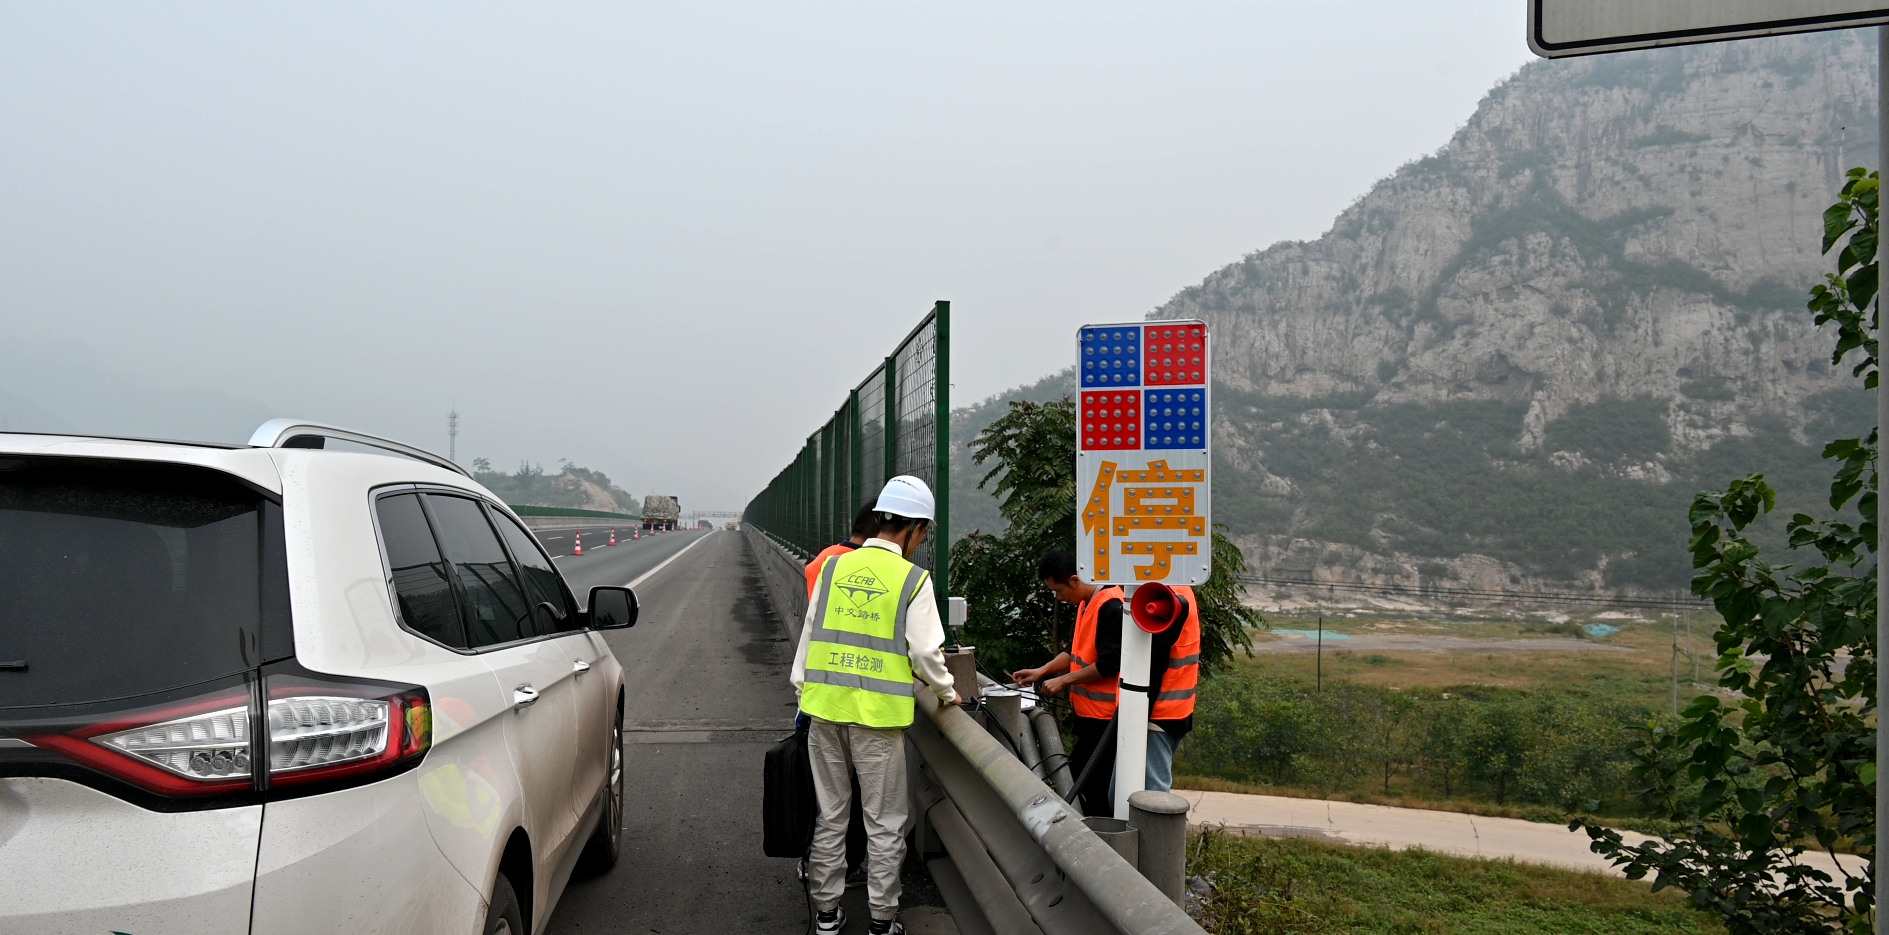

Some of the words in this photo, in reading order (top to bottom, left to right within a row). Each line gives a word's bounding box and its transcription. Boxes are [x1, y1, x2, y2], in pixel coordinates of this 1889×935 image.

[1082, 460, 1205, 580] 停
[834, 606, 881, 622] 中交路桥
[828, 652, 884, 673] 工程检测
